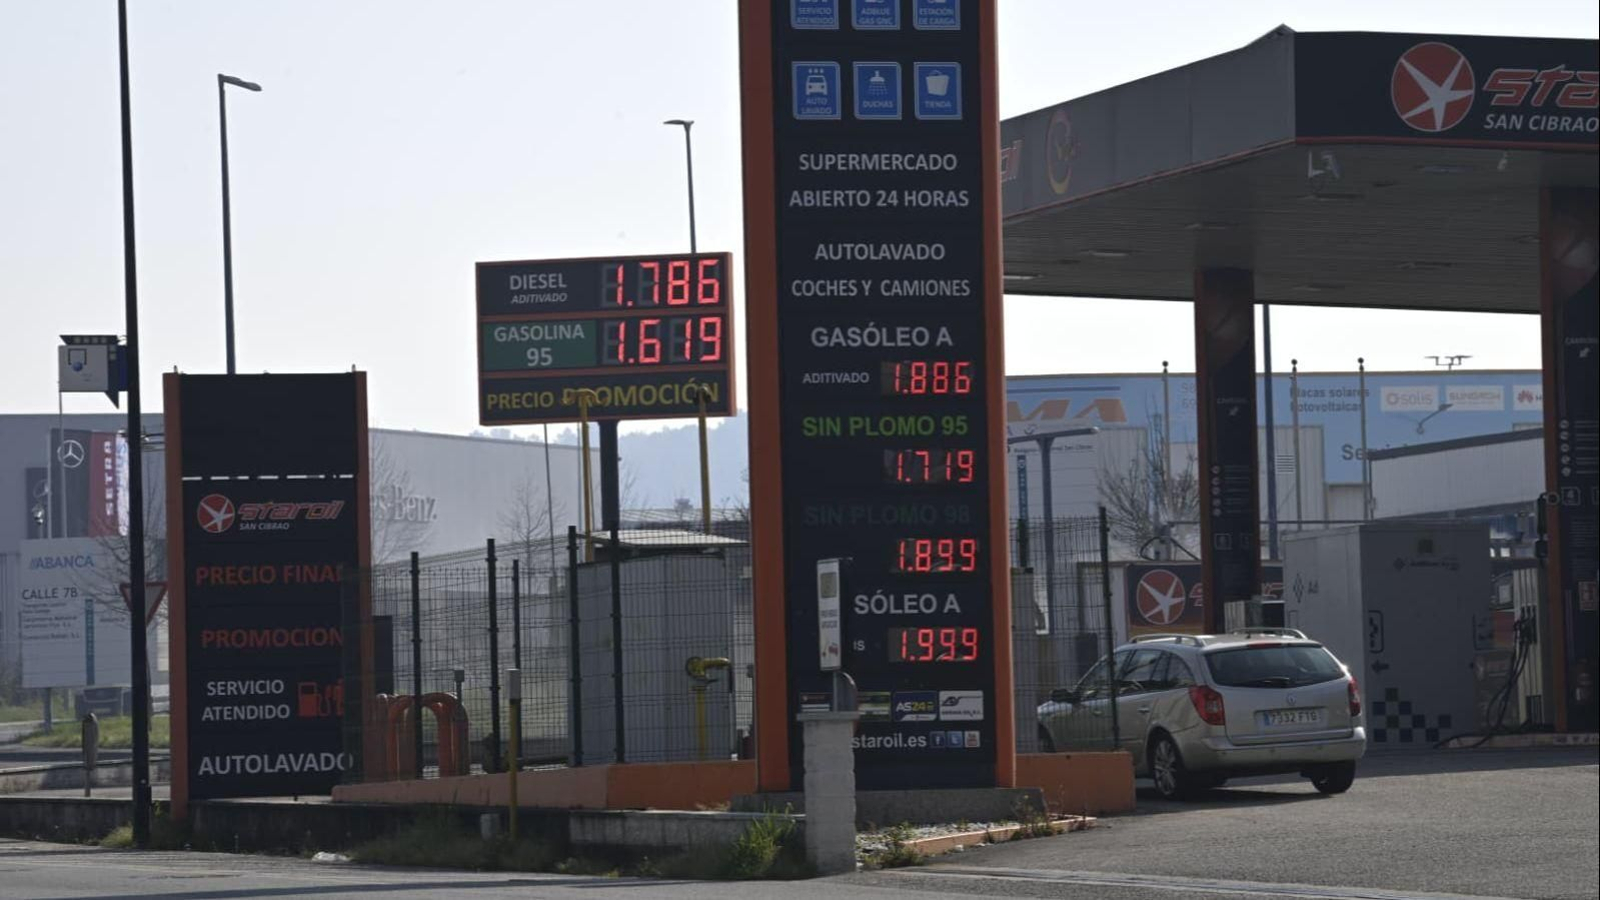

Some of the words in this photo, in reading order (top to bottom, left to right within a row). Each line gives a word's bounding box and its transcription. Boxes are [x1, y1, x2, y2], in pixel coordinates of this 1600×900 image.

[798, 7, 831, 15] SERVICIO
[859, 17, 875, 25] GAS
[806, 97, 827, 105] AUTO
[1484, 114, 1523, 130] SAN
[1528, 115, 1599, 132] CIBRAO
[799, 153, 957, 171] SUPERMERCADO
[789, 190, 870, 207] ABIERTO
[876, 190, 899, 207] 24
[904, 190, 969, 207] HORAS
[815, 243, 946, 260] AUTOLAVADO
[509, 273, 567, 291] DIESEL
[616, 259, 720, 306] 1.786
[791, 279, 858, 297] COCHES
[861, 279, 872, 296] Y
[880, 279, 970, 297] CAMIONES
[511, 292, 567, 304] ADITIVADO
[494, 323, 585, 342] GASOLINA
[617, 316, 721, 364] 1.619
[811, 321, 930, 347] GASÓLEO
[936, 327, 953, 346] A
[526, 347, 553, 367] 95
[803, 372, 870, 384] ADITIVADO
[894, 362, 971, 394] 1.886
[487, 390, 554, 410] PRECIO
[803, 416, 841, 436] SIN
[850, 416, 935, 436] PLOMO
[941, 415, 968, 435] 95
[897, 450, 974, 482] 1.719
[804, 505, 842, 526] SIN
[851, 504, 937, 525] PLOMO
[943, 504, 970, 524] 98
[239, 522, 256, 531] SAN
[899, 539, 976, 572] 1.899
[196, 566, 277, 586] PRECIO
[22, 589, 59, 600] CALLE
[854, 590, 937, 615] SÓLEO
[943, 594, 961, 613] A
[901, 628, 978, 661] 1.999
[207, 679, 285, 695] SERVICIO
[201, 704, 291, 721] ATENDIDO
[198, 752, 353, 776] AUTOLAVADO
